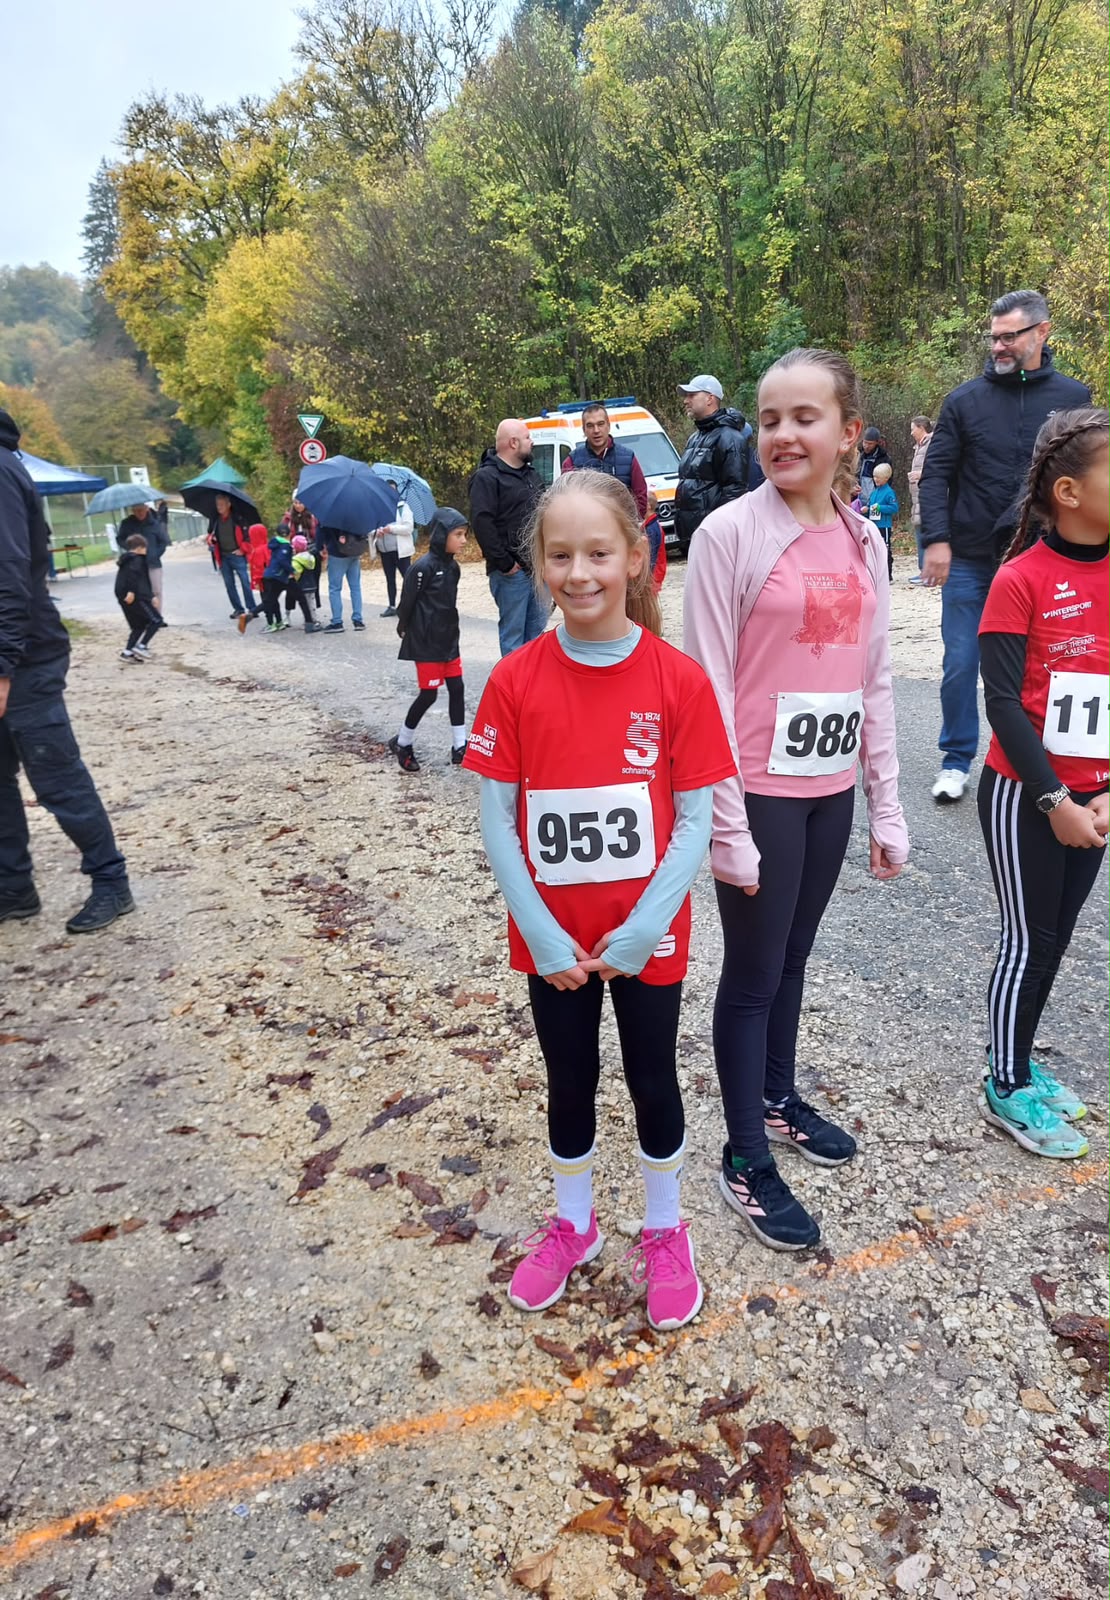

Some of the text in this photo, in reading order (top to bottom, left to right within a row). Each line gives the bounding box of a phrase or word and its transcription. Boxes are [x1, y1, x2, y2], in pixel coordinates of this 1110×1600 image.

[1054, 590, 1077, 600] erima
[1050, 601, 1093, 617] INTERSPORT
[1064, 645, 1087, 656] AALEN
[630, 711, 661, 722] tsg 1874
[1053, 694, 1110, 735] 11
[786, 711, 860, 758] 988
[537, 807, 641, 864] 953
